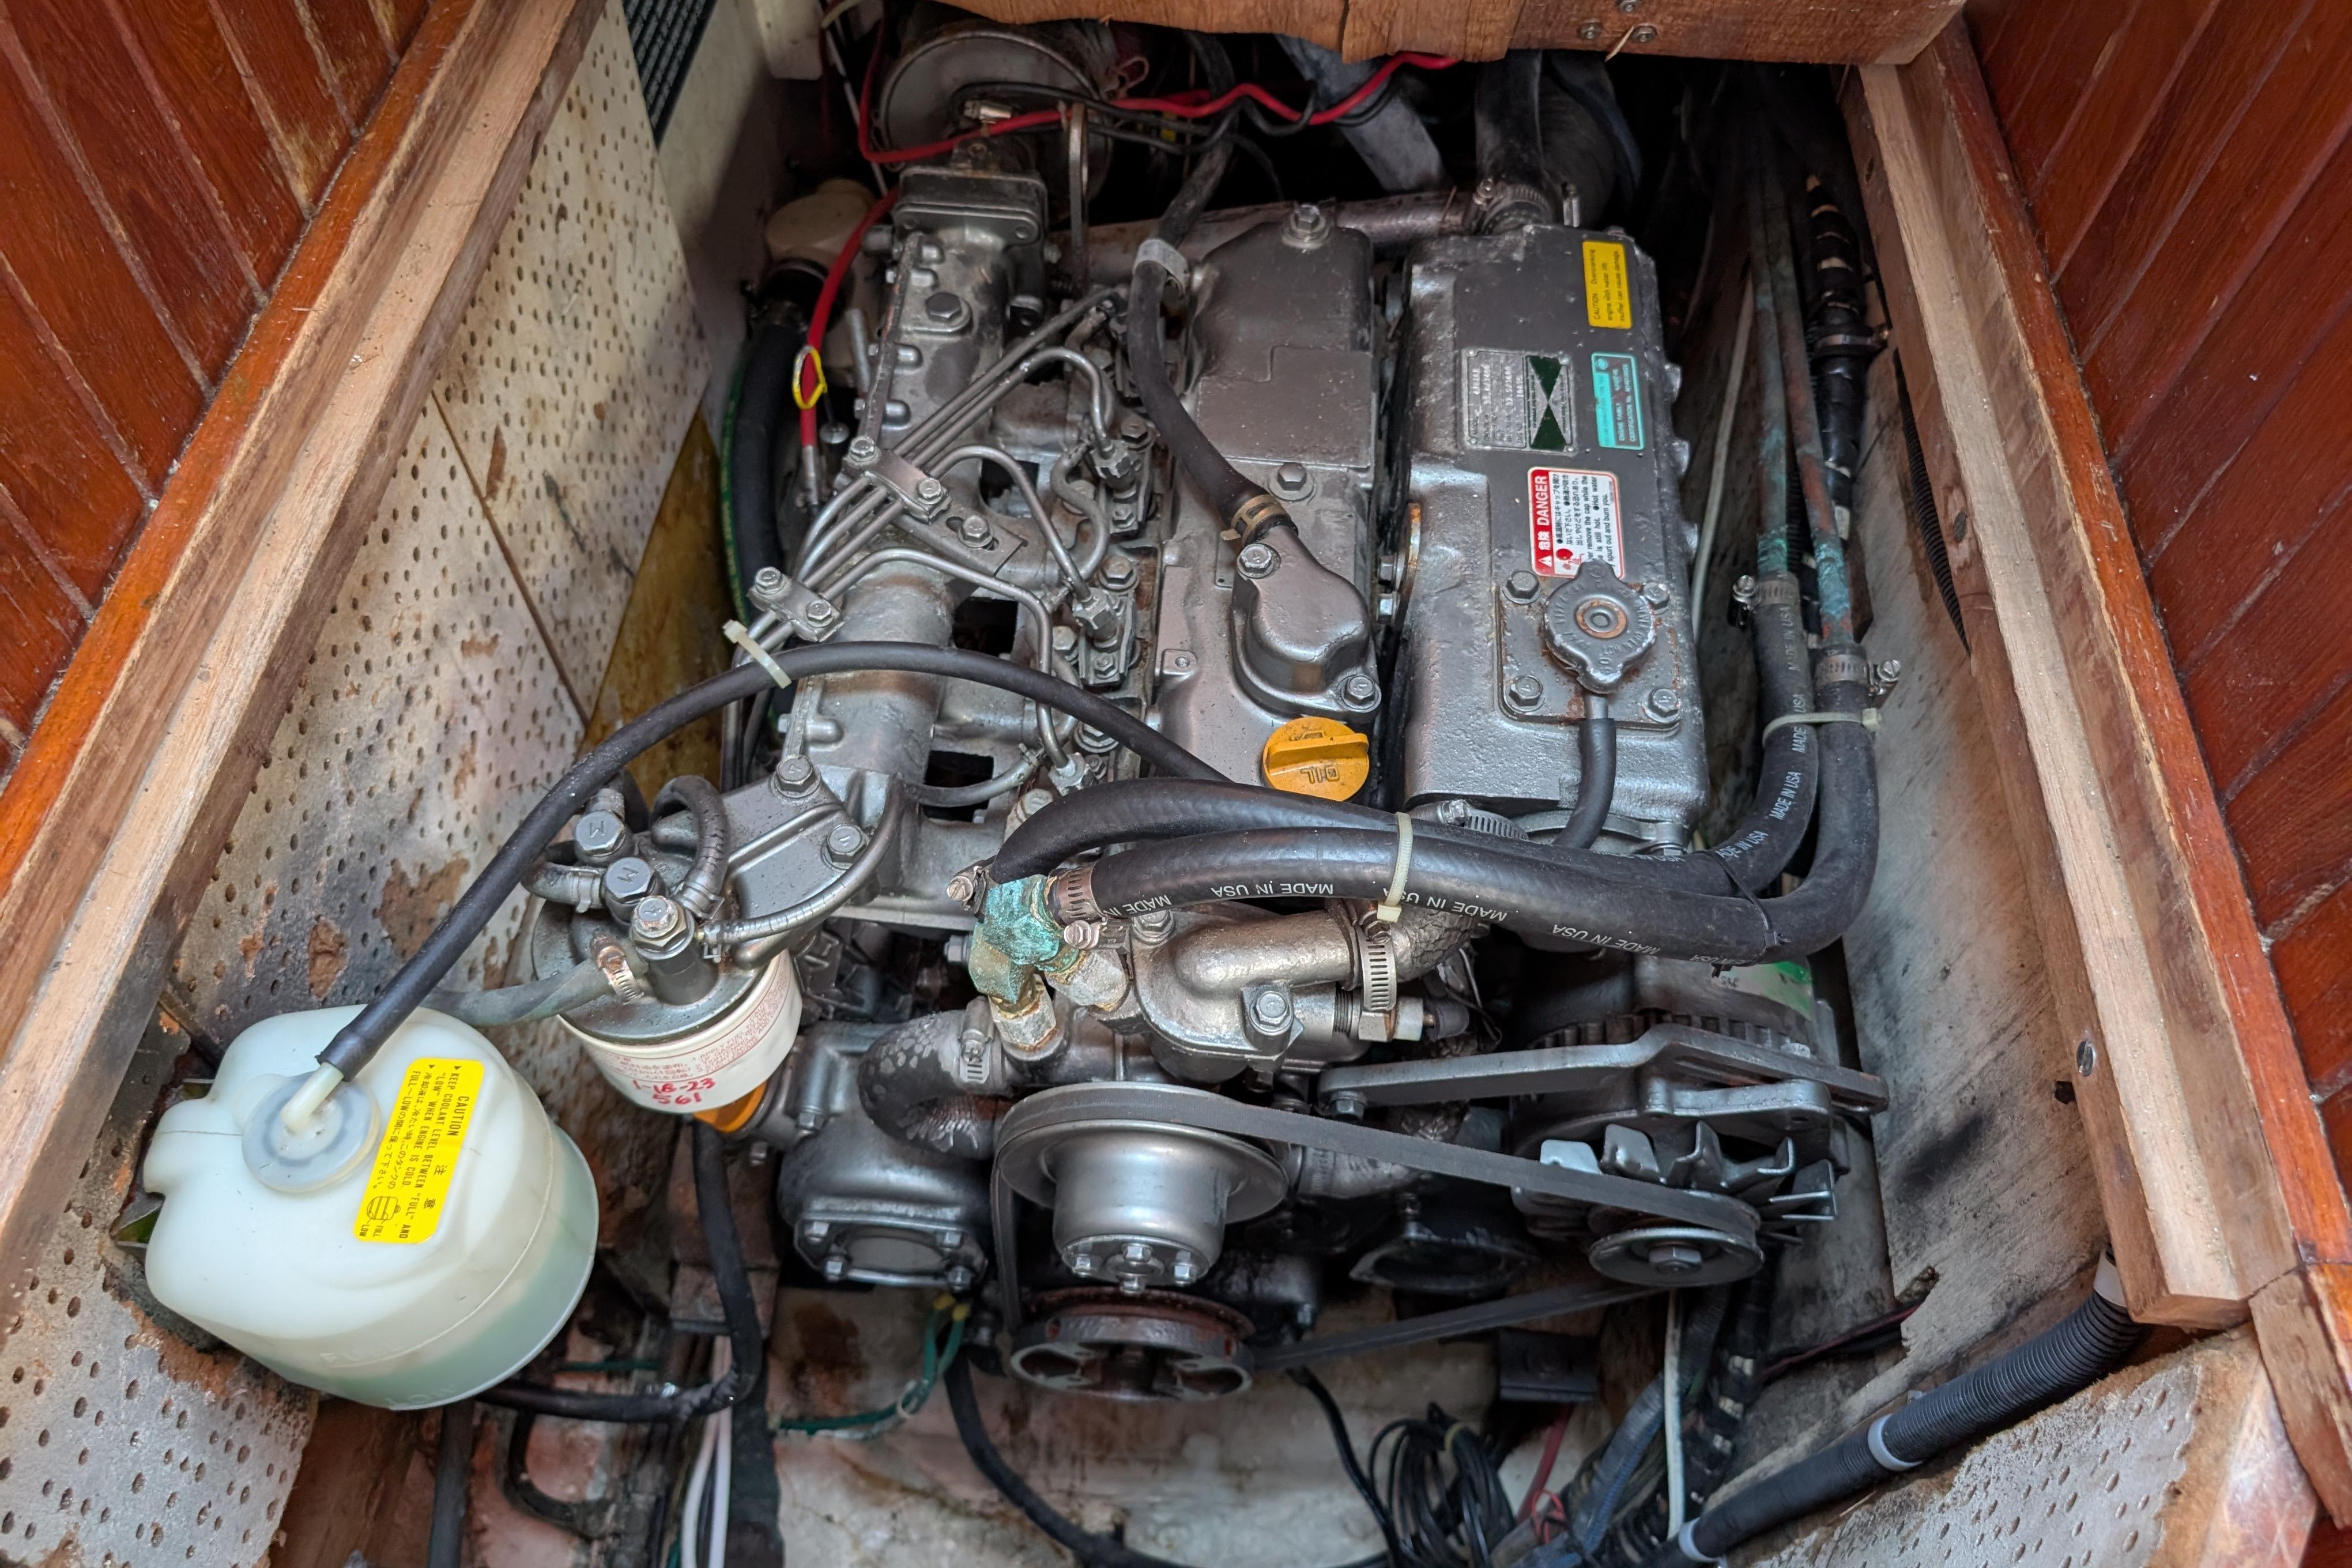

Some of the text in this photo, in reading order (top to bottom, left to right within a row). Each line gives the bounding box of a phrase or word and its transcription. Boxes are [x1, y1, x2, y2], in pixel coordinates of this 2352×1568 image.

[1535, 476, 1550, 550] 危険 DANGER
[1781, 606, 1792, 625] USA
[1792, 693, 1806, 753] MADE USA
[1301, 766, 1340, 785] OIL
[1769, 770, 1800, 819] MADE IN USA
[1735, 840, 1751, 850] IN
[1746, 830, 1767, 843] USA
[1211, 883, 1333, 898] MADE IN USA
[1122, 894, 1171, 916] MADE
[1427, 895, 1448, 909] IN
[1453, 901, 1507, 922] MADE
[1551, 923, 1660, 956] MADE IN USA
[447, 1073, 459, 1089] KEEP
[633, 1077, 716, 1094] 1-18-23
[435, 1093, 451, 1124] COOLANT
[652, 1092, 703, 1106] 561
[423, 1100, 436, 1121] WHEN
[446, 1096, 469, 1136] CAUTION
[413, 1125, 428, 1149] ENGINE
[427, 1129, 440, 1149] LEVEL
[409, 1154, 419, 1162] IS
[401, 1167, 414, 1188] COLD.
[414, 1154, 433, 1189] BETWEEN
[359, 1224, 369, 1237] LOW
[372, 1225, 383, 1238] FULL
[398, 1224, 410, 1239] AND
